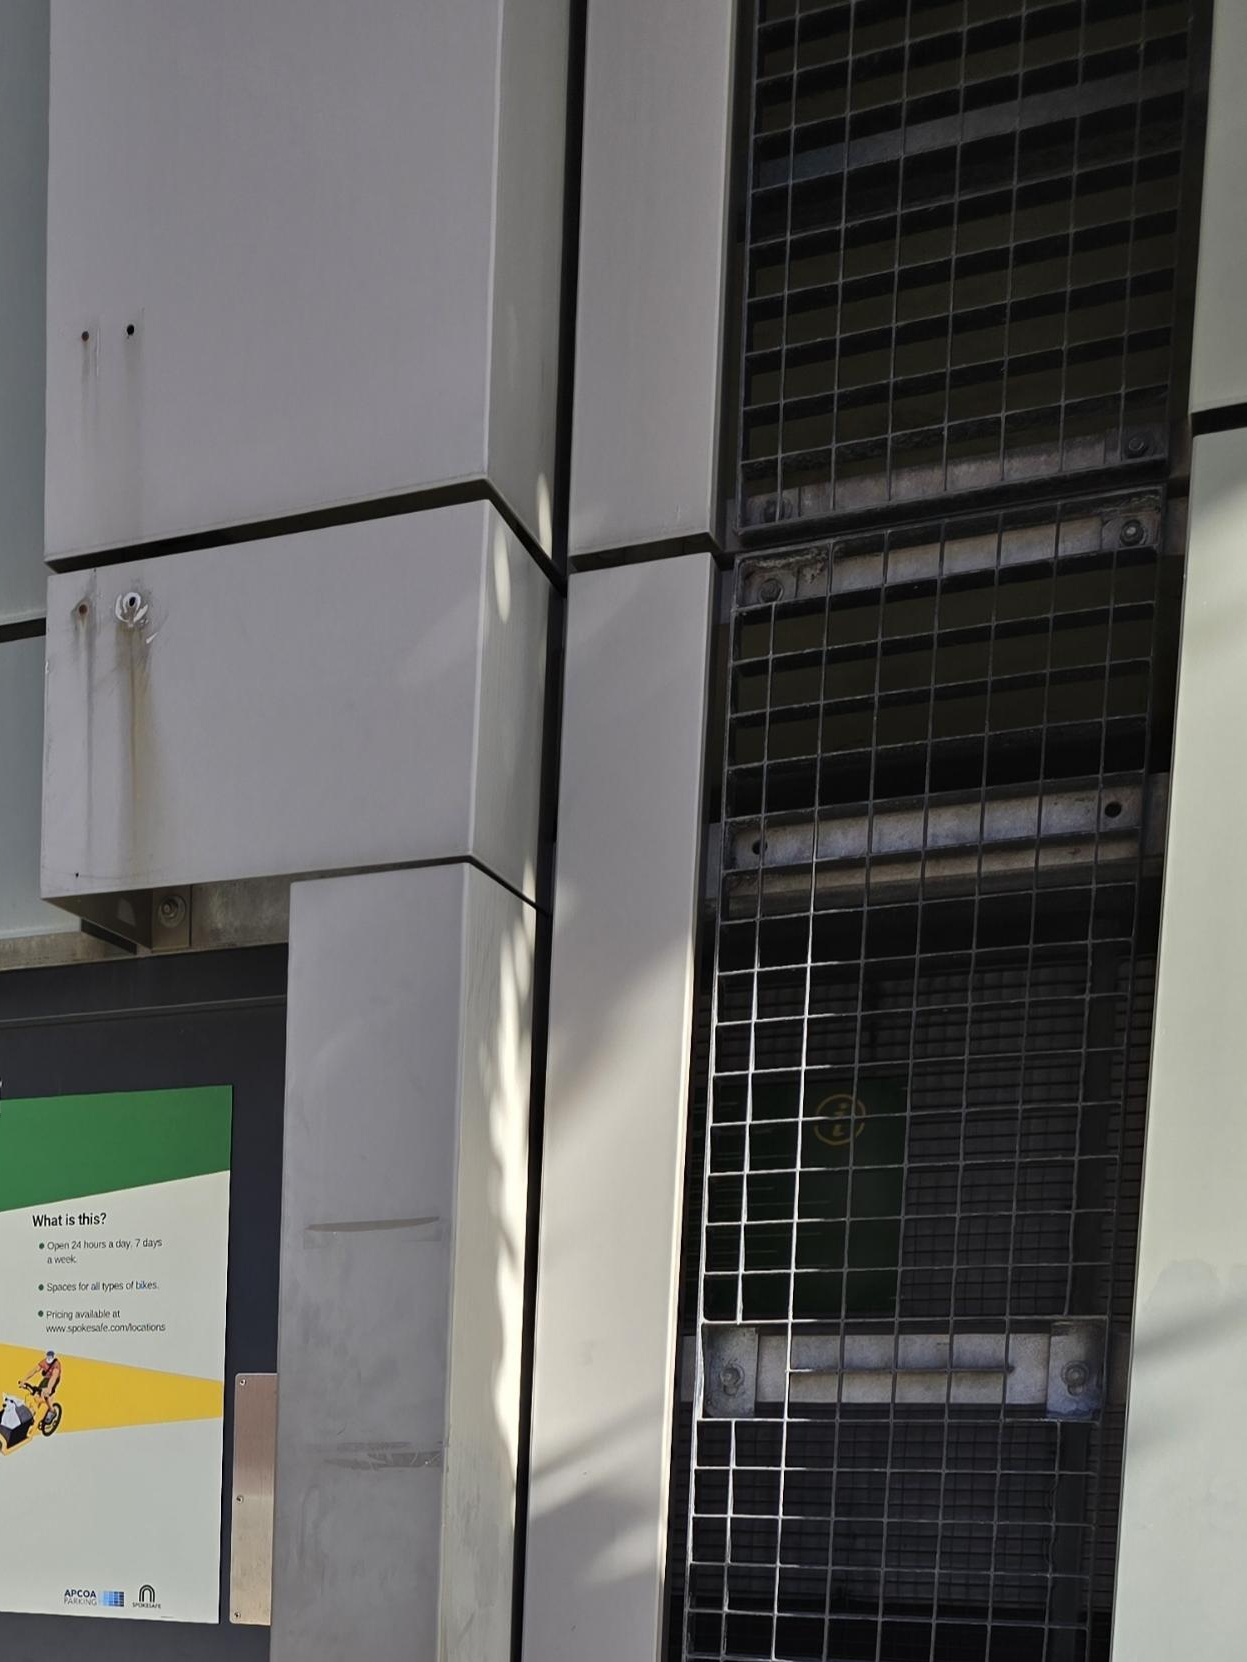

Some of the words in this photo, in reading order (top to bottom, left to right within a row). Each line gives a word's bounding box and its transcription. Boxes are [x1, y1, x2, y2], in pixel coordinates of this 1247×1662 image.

[32, 1214, 62, 1227] What
[65, 1213, 75, 1226] is
[78, 1212, 107, 1226] this?
[47, 1241, 70, 1252] Open
[71, 1240, 81, 1249] 24
[83, 1239, 106, 1249] hours
[135, 1238, 141, 1247] 7
[142, 1238, 163, 1249] days
[47, 1256, 52, 1264] a
[47, 1282, 76, 1293] Spaces
[78, 1281, 89, 1291] for
[90, 1281, 100, 1291] all
[102, 1281, 124, 1292] types
[125, 1280, 134, 1290] of
[135, 1280, 159, 1290] bikes.
[46, 1310, 73, 1321] Pricing
[75, 1309, 111, 1319] available
[112, 1309, 121, 1318] at
[45, 1322, 167, 1335] www.spokesafe.com/locations
[64, 1589, 97, 1598] APCOA
[64, 1598, 97, 1606] PARKING
